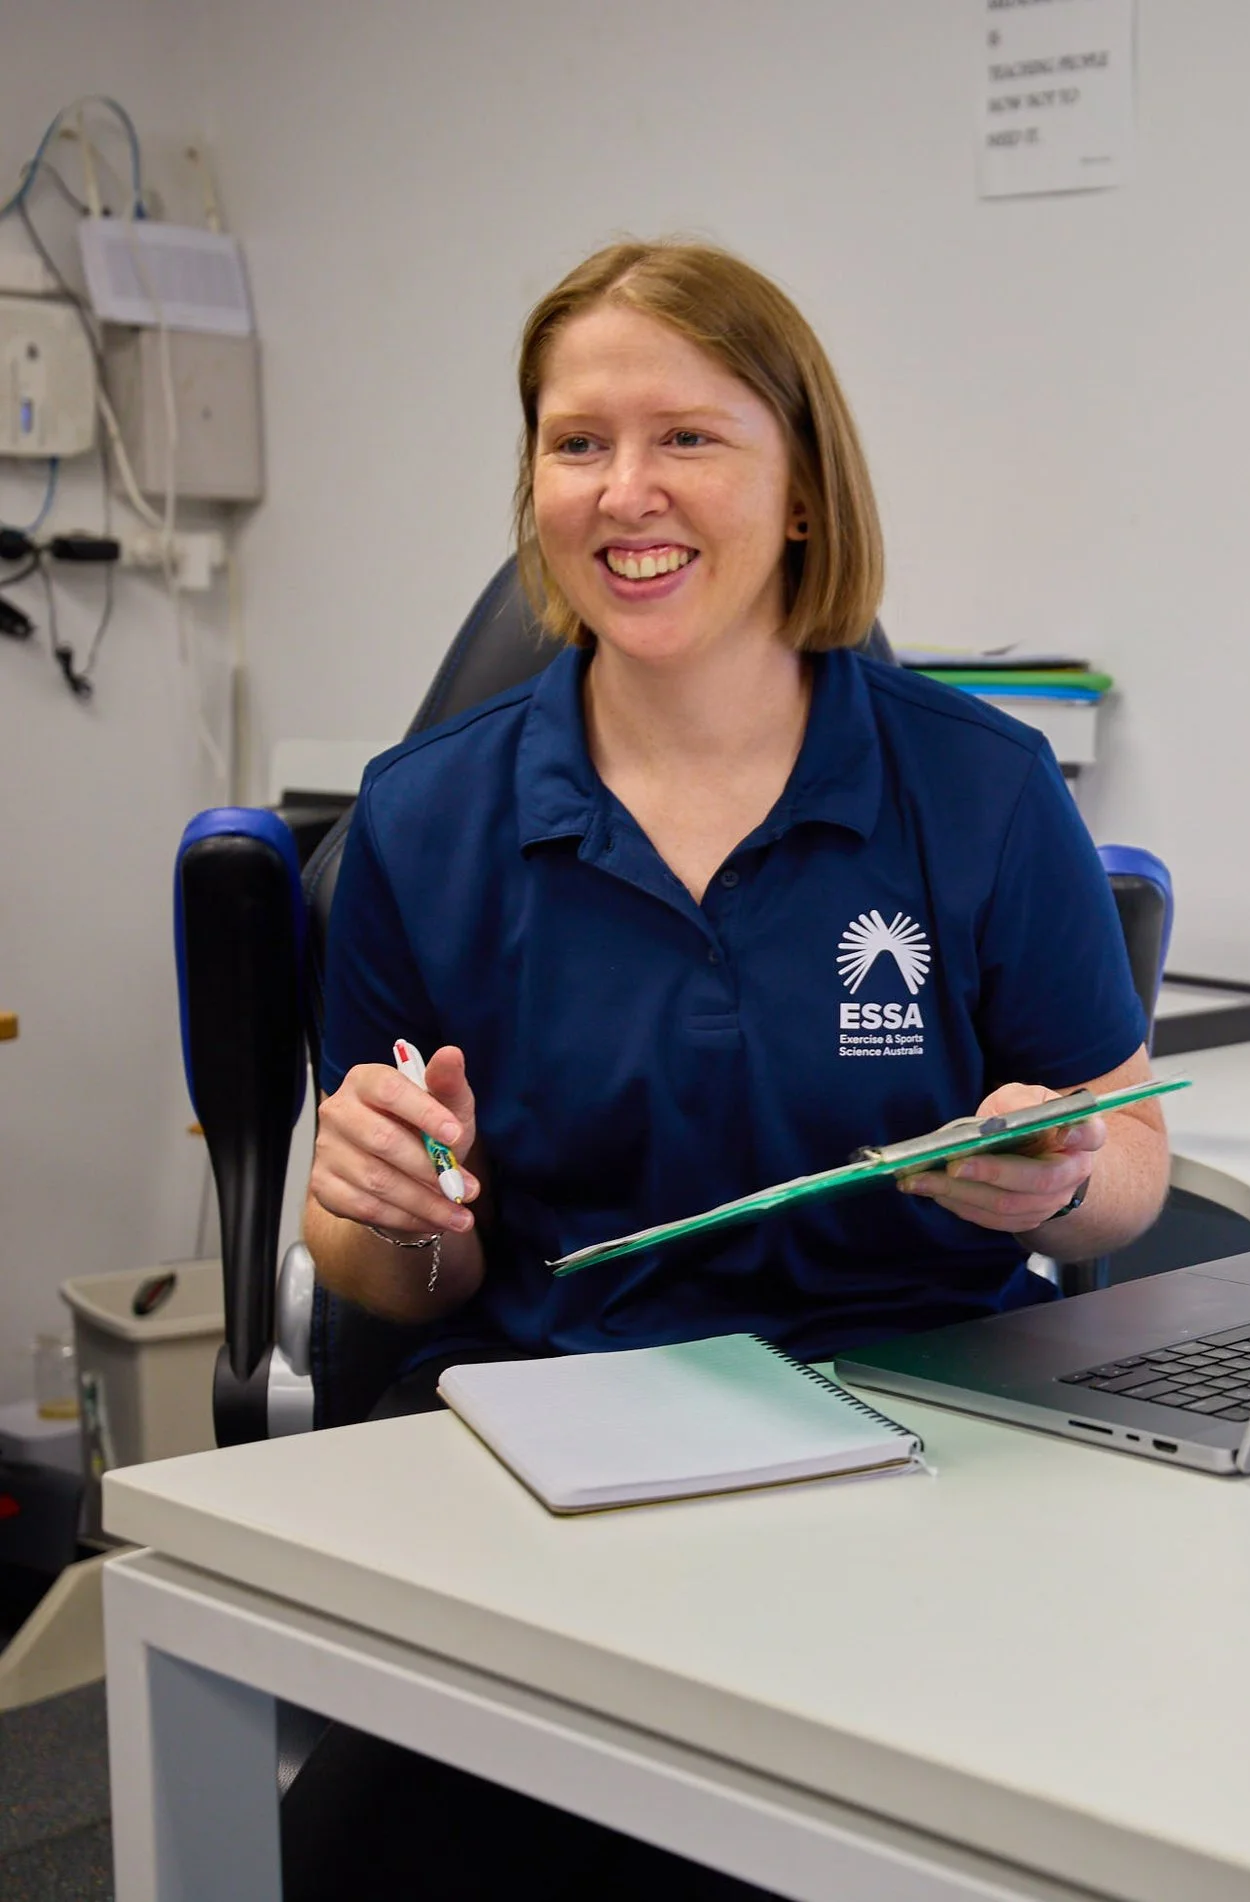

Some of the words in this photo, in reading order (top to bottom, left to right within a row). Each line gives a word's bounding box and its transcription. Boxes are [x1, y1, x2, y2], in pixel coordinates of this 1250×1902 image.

[840, 1003, 924, 1030] ESSA
[840, 1034, 884, 1044] Exercise
[885, 1034, 893, 1044] &
[895, 1034, 923, 1045] Sports
[839, 1046, 881, 1056] Science
[883, 1045, 923, 1056] Australia
